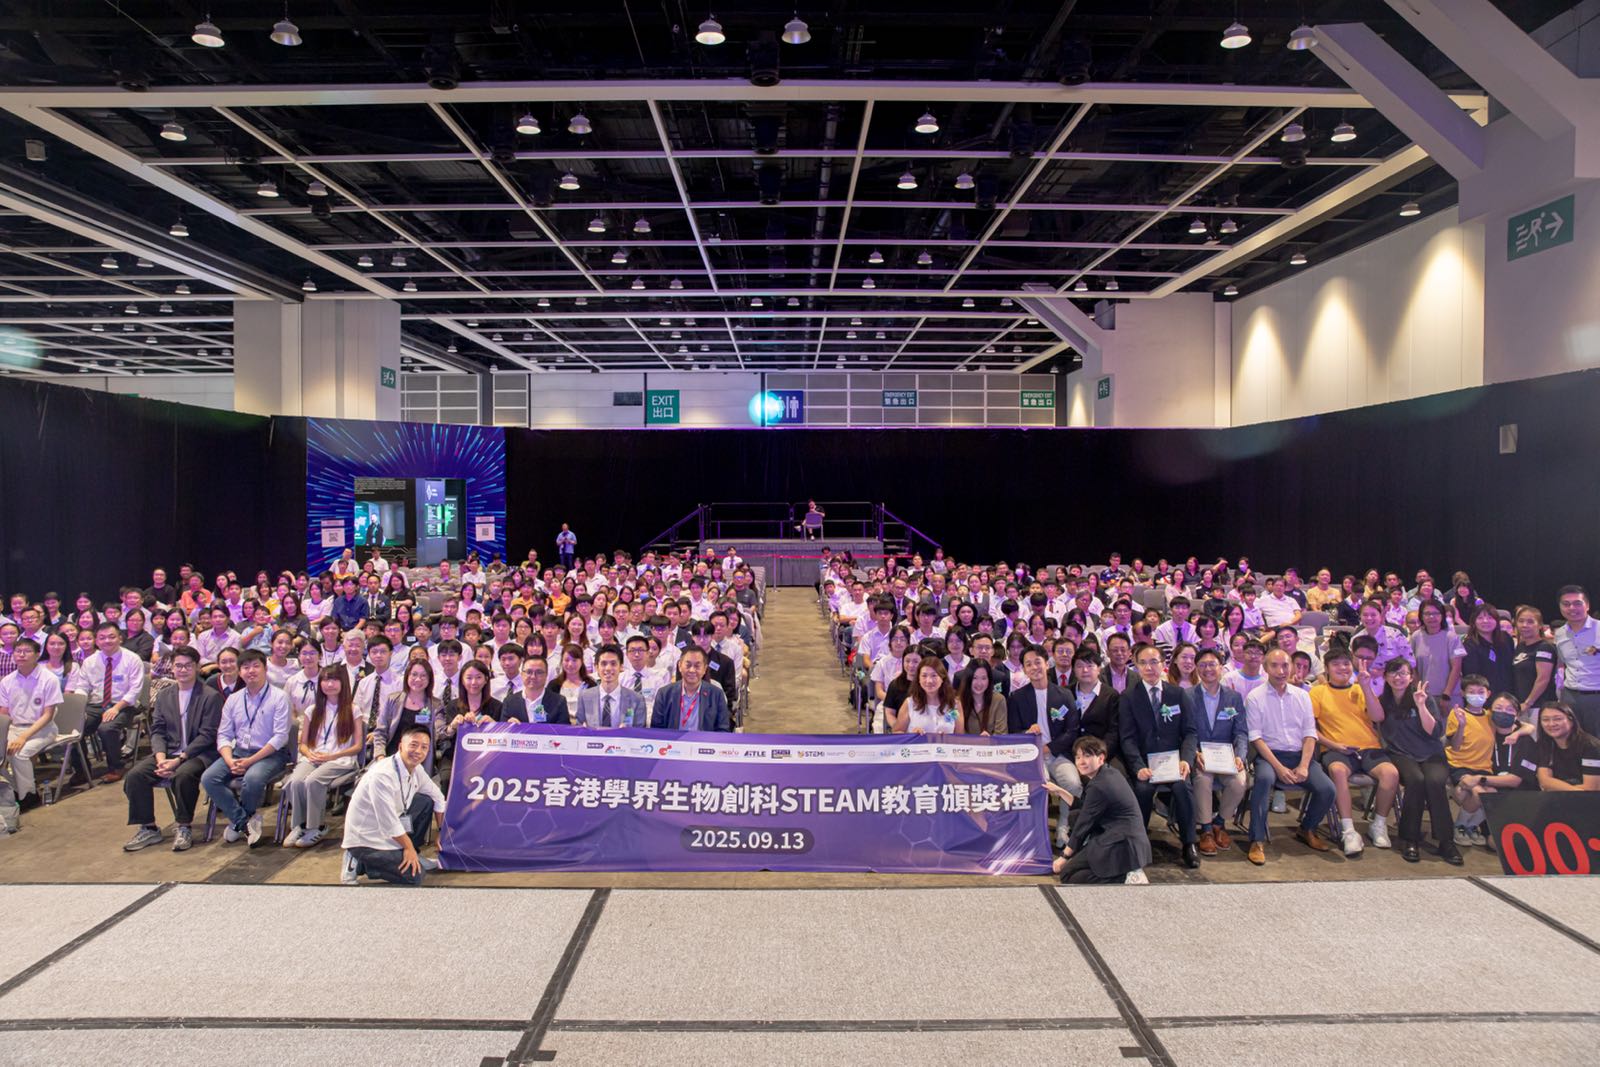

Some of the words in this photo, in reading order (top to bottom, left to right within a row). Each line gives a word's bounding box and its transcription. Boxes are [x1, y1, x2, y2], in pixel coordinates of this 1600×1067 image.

[651, 395, 675, 406] EXIT
[652, 407, 674, 418] 出口
[690, 829, 805, 850] 2025.09.13
